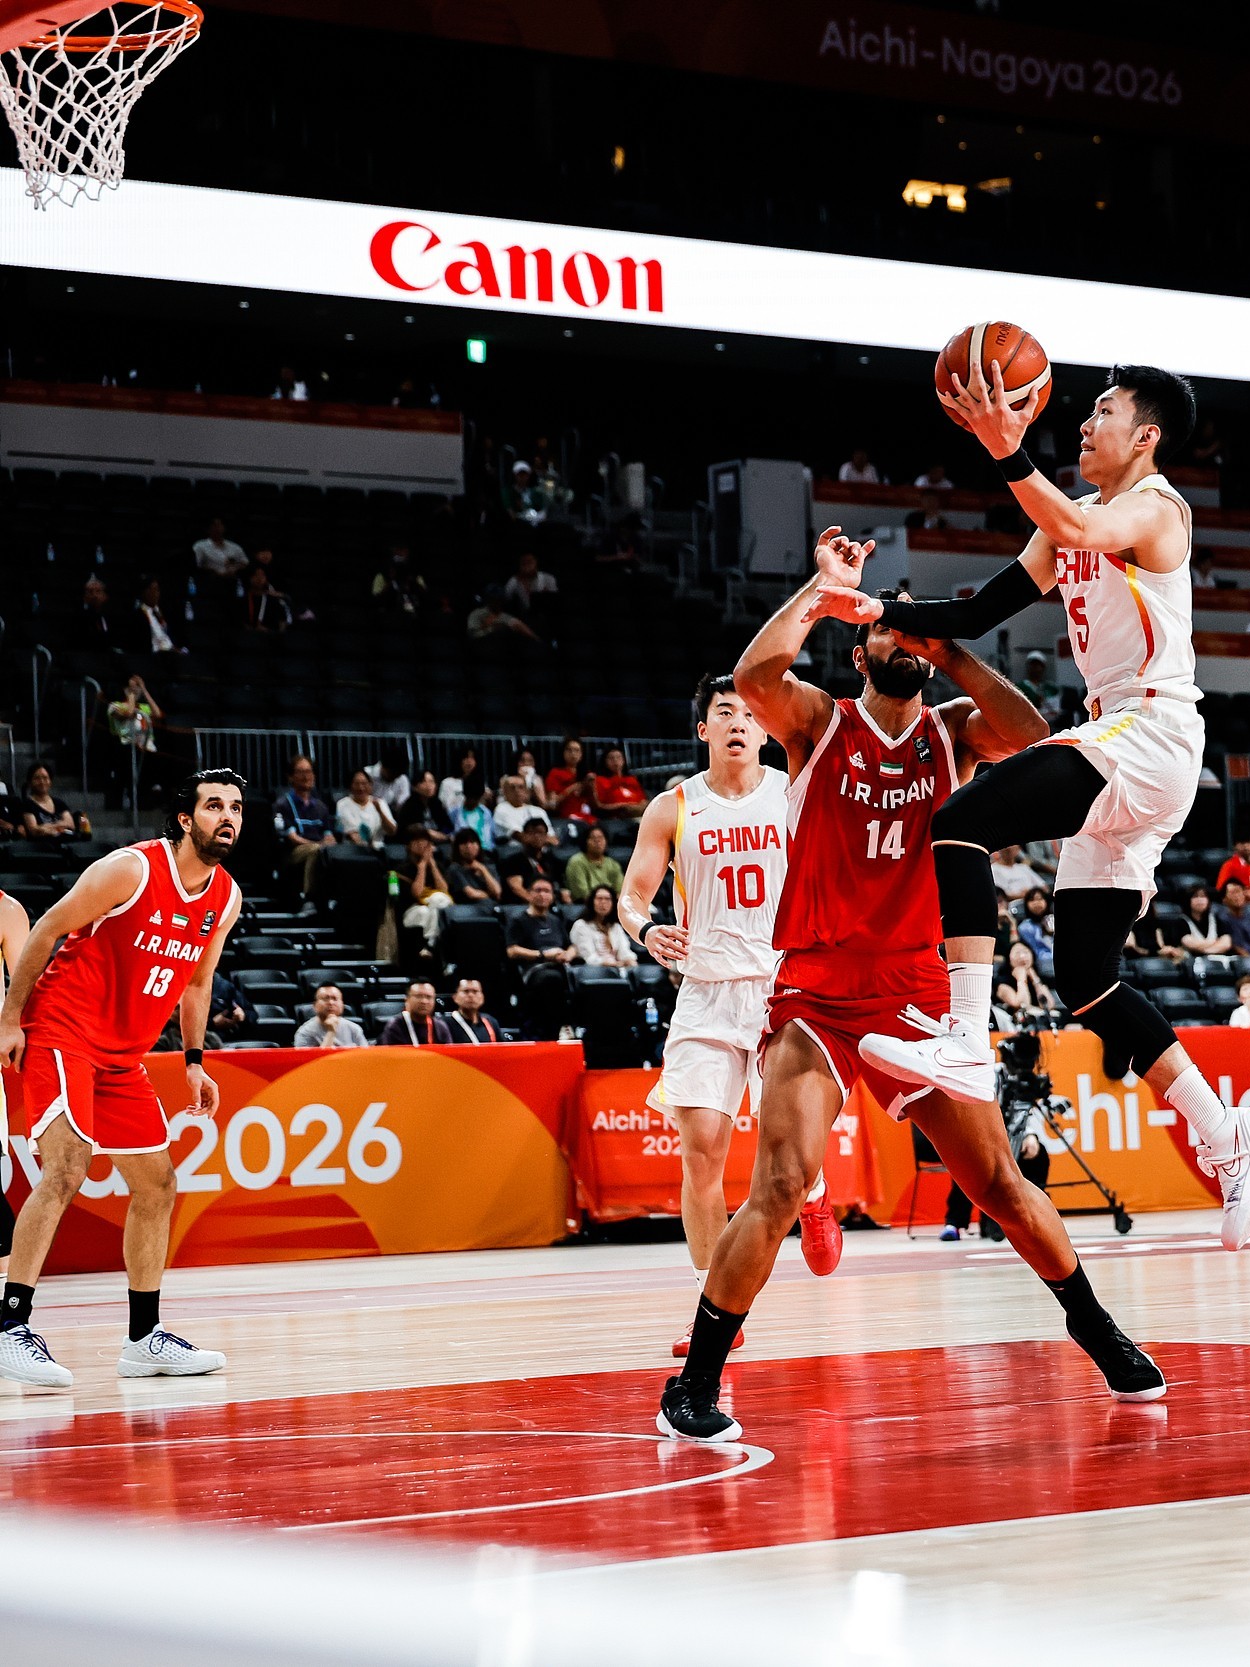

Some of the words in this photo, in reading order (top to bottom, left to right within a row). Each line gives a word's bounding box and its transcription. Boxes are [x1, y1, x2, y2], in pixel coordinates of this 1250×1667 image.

[819, 19, 1086, 98] Aichi-Nagoya
[1092, 60, 1183, 105] 2026
[369, 220, 664, 313] Canon
[1068, 595, 1090, 654] 5
[698, 824, 782, 856] CHINA
[866, 819, 906, 860] 14
[716, 864, 766, 911] 10
[142, 965, 175, 998] 13
[171, 1101, 403, 1194] 2026
[641, 1135, 682, 1156] 202
